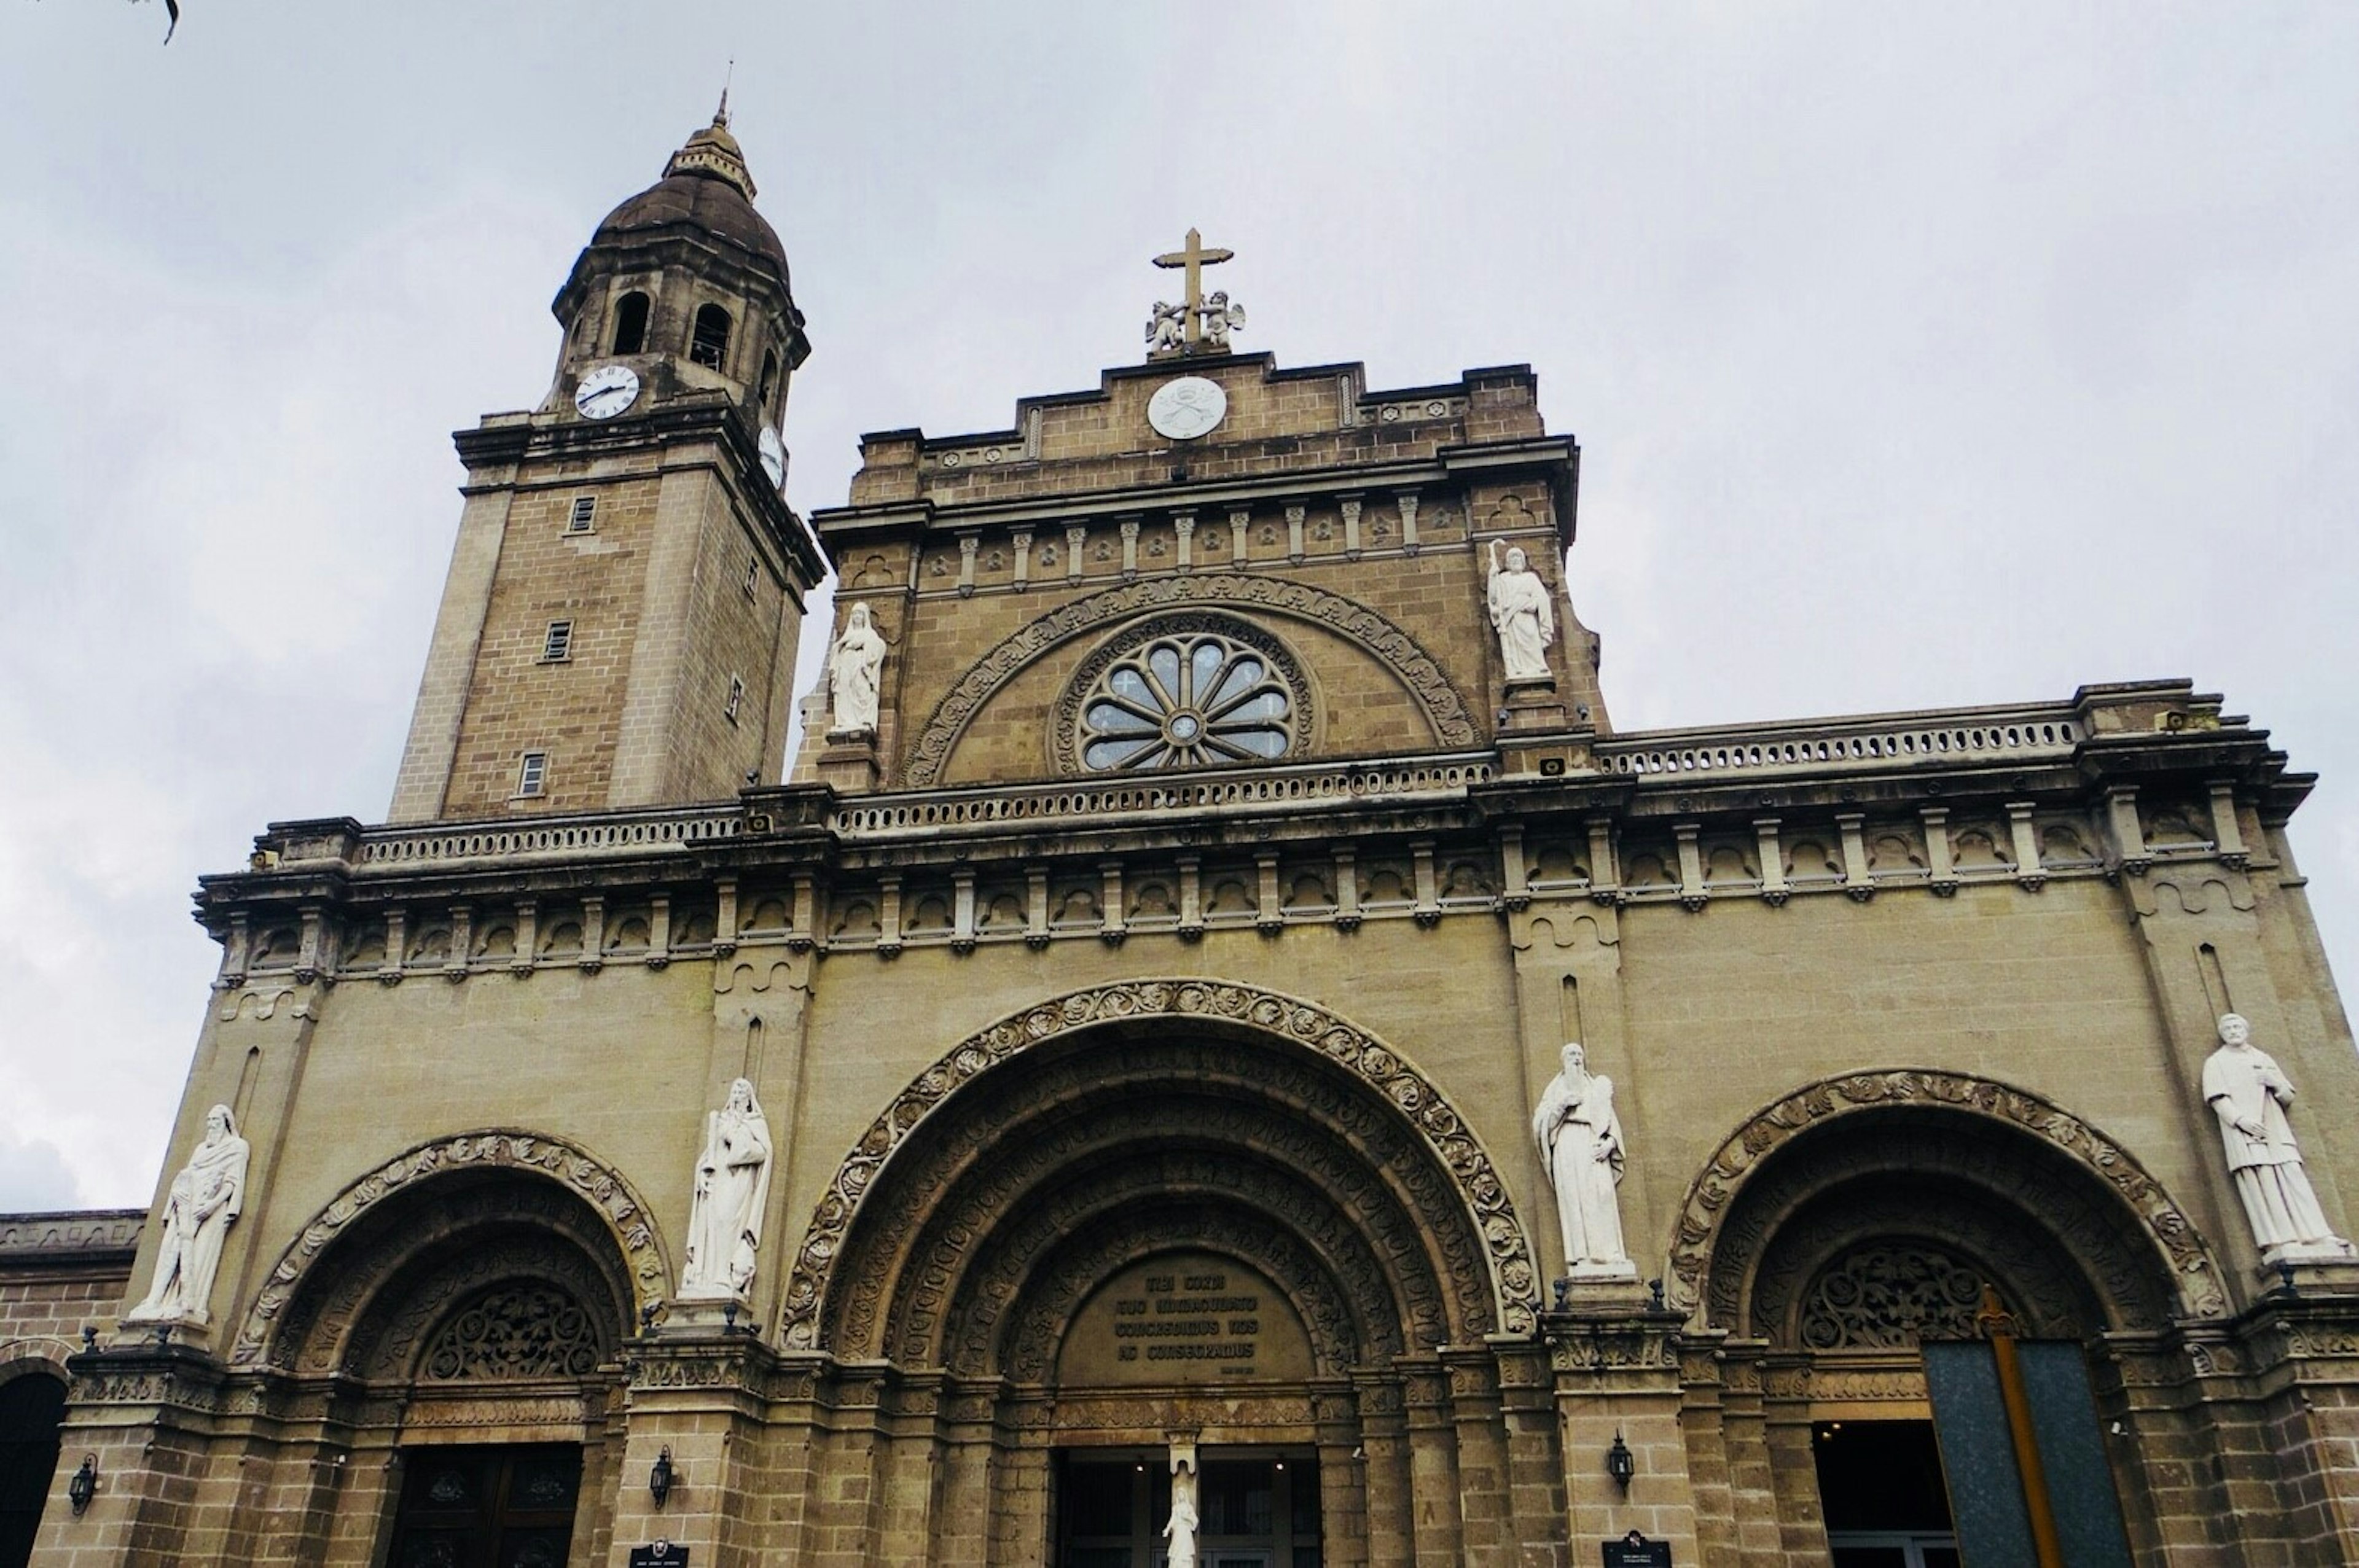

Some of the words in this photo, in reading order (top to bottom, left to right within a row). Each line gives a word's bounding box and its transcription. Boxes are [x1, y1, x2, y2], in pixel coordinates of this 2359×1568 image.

[1146, 1276, 1175, 1292] TIBI
[1184, 1275, 1225, 1290] CORDI
[1116, 1320, 1219, 1337] CONCREDIMUS
[1229, 1319, 1258, 1335] NOS
[1118, 1345, 1137, 1361] AC
[1147, 1343, 1254, 1360] CONSECRAMUS
